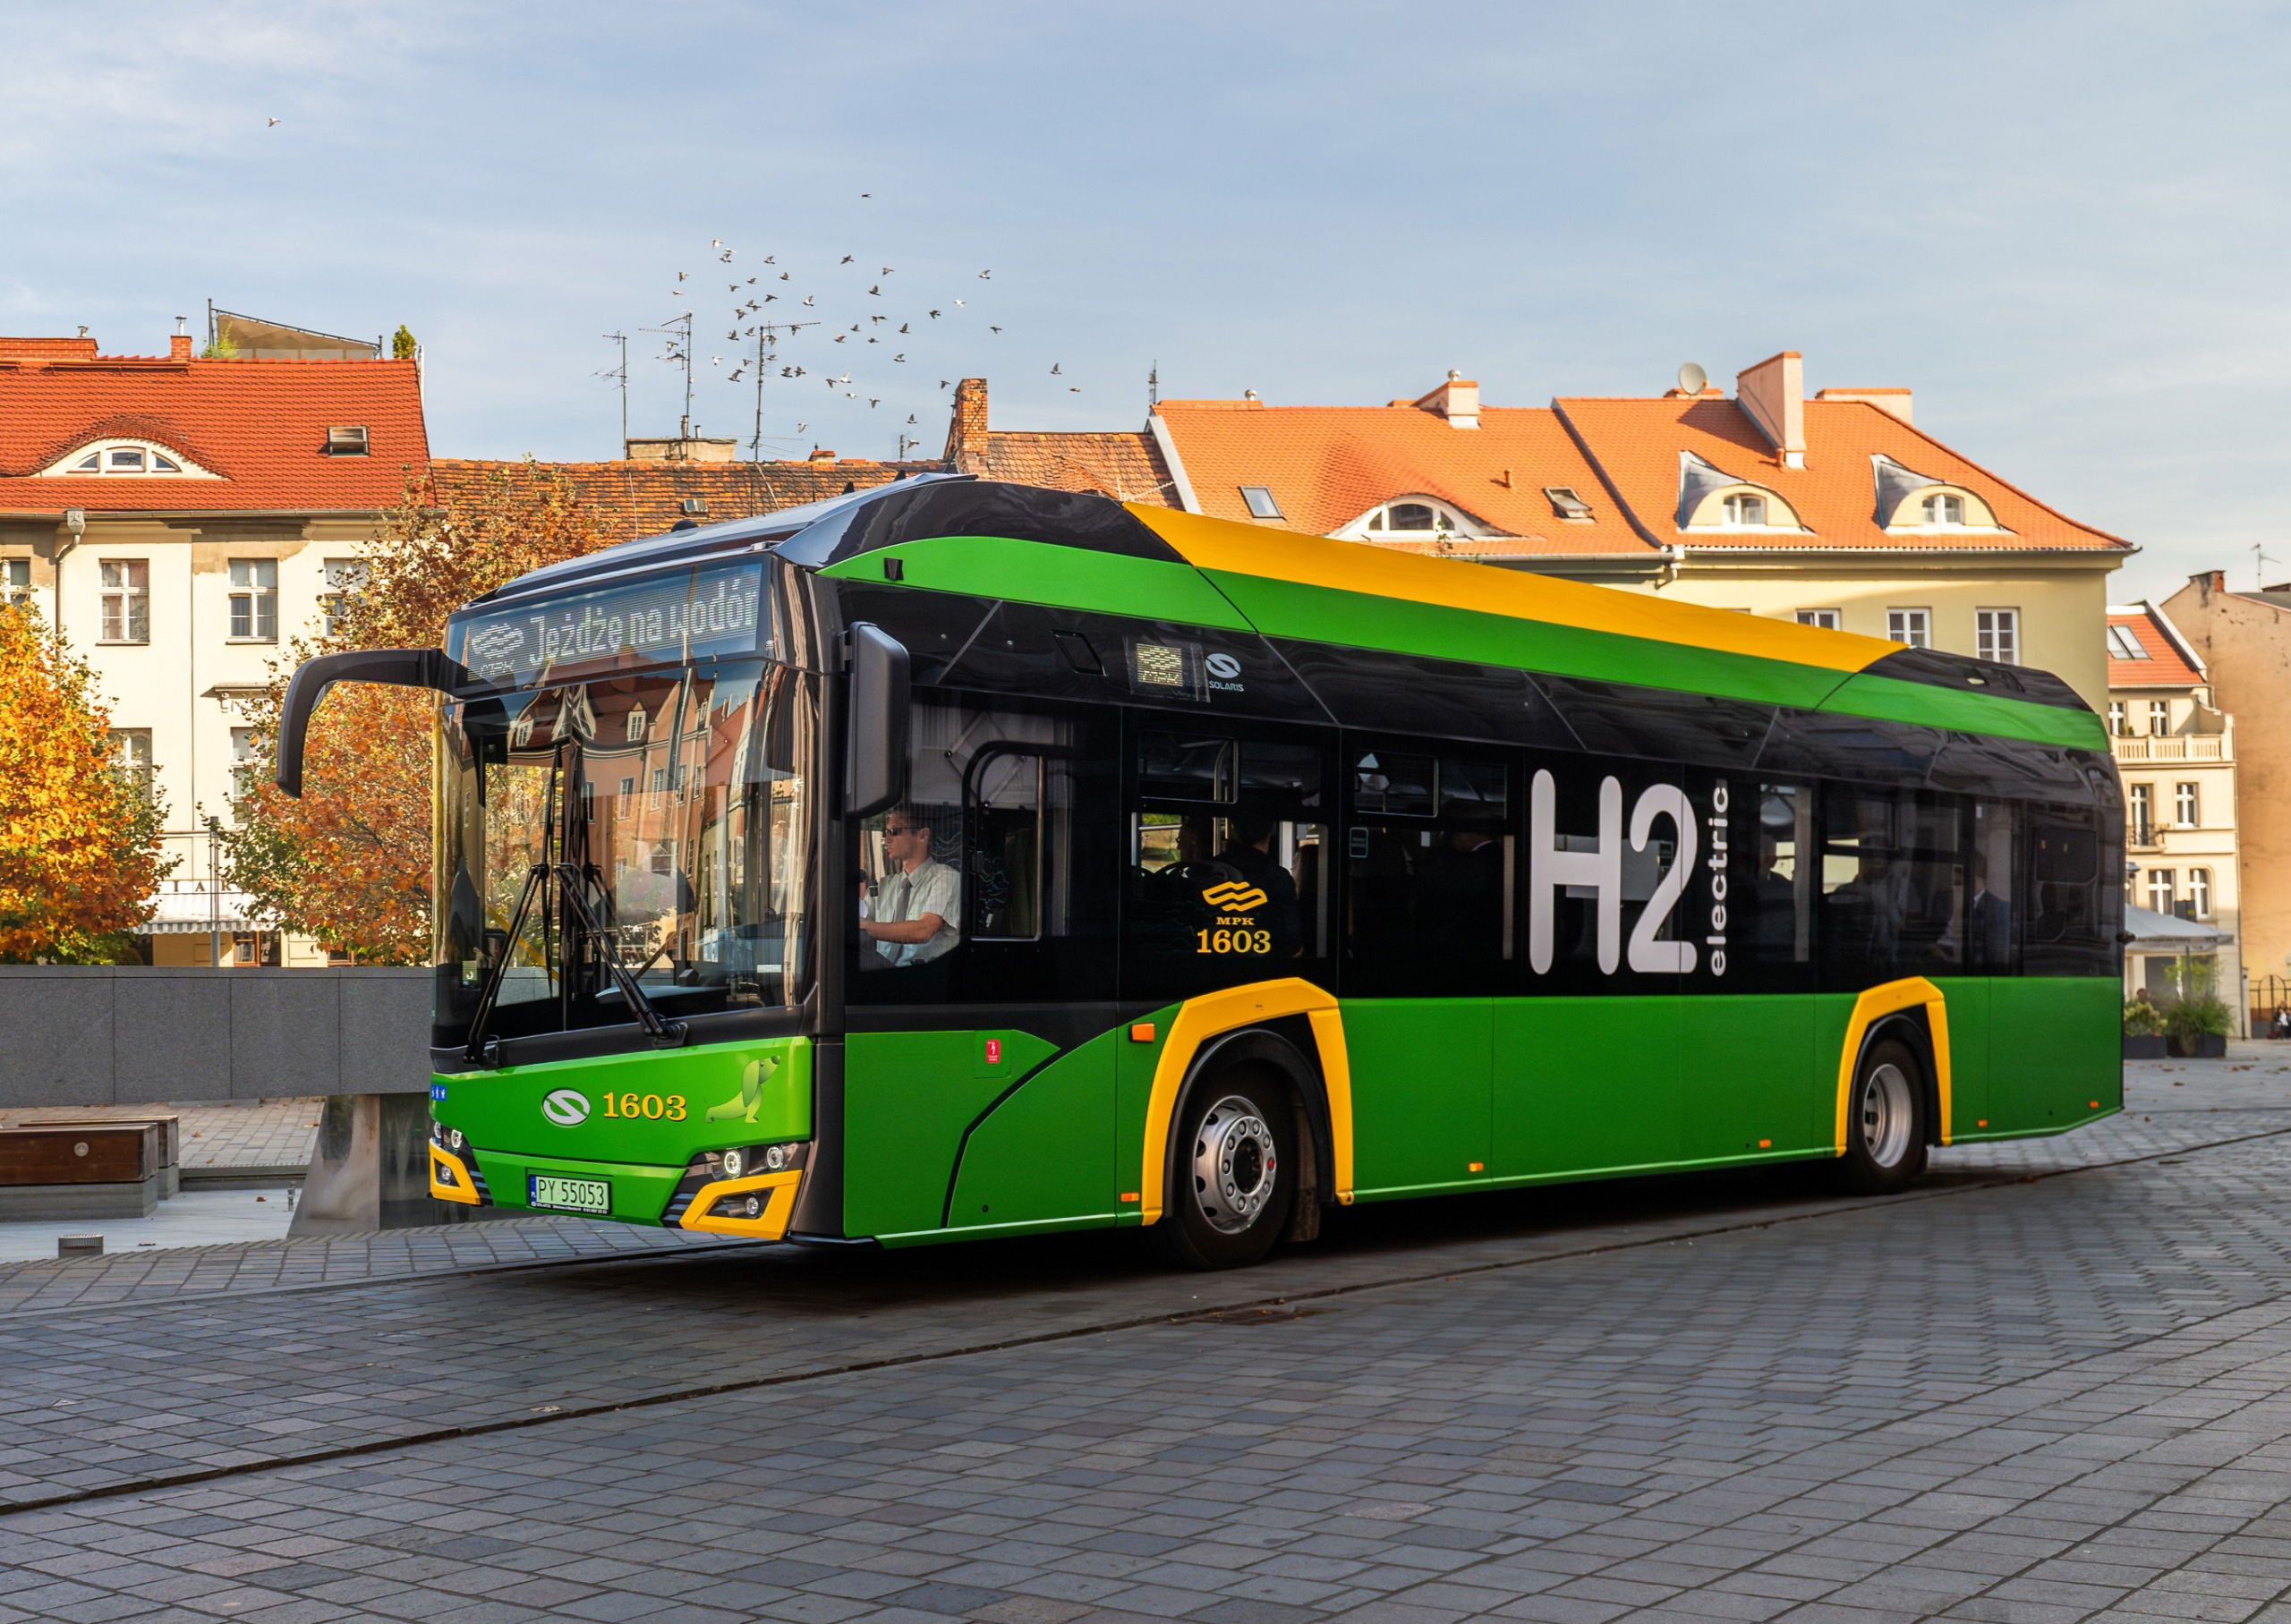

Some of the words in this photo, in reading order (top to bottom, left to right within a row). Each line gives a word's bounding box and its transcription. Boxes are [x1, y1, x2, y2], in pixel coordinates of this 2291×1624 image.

[530, 608, 623, 666] Jeżdżę
[629, 608, 662, 644] na
[669, 579, 758, 638] wodór
[1208, 680, 1244, 692] SOLARIS
[1529, 769, 1698, 975] H2
[1707, 786, 1728, 977] electric
[1215, 916, 1255, 925] MPK
[1197, 929, 1271, 954] 1603
[602, 1092, 688, 1122] 1603
[538, 1178, 555, 1201] PY
[561, 1181, 604, 1206] 55053
